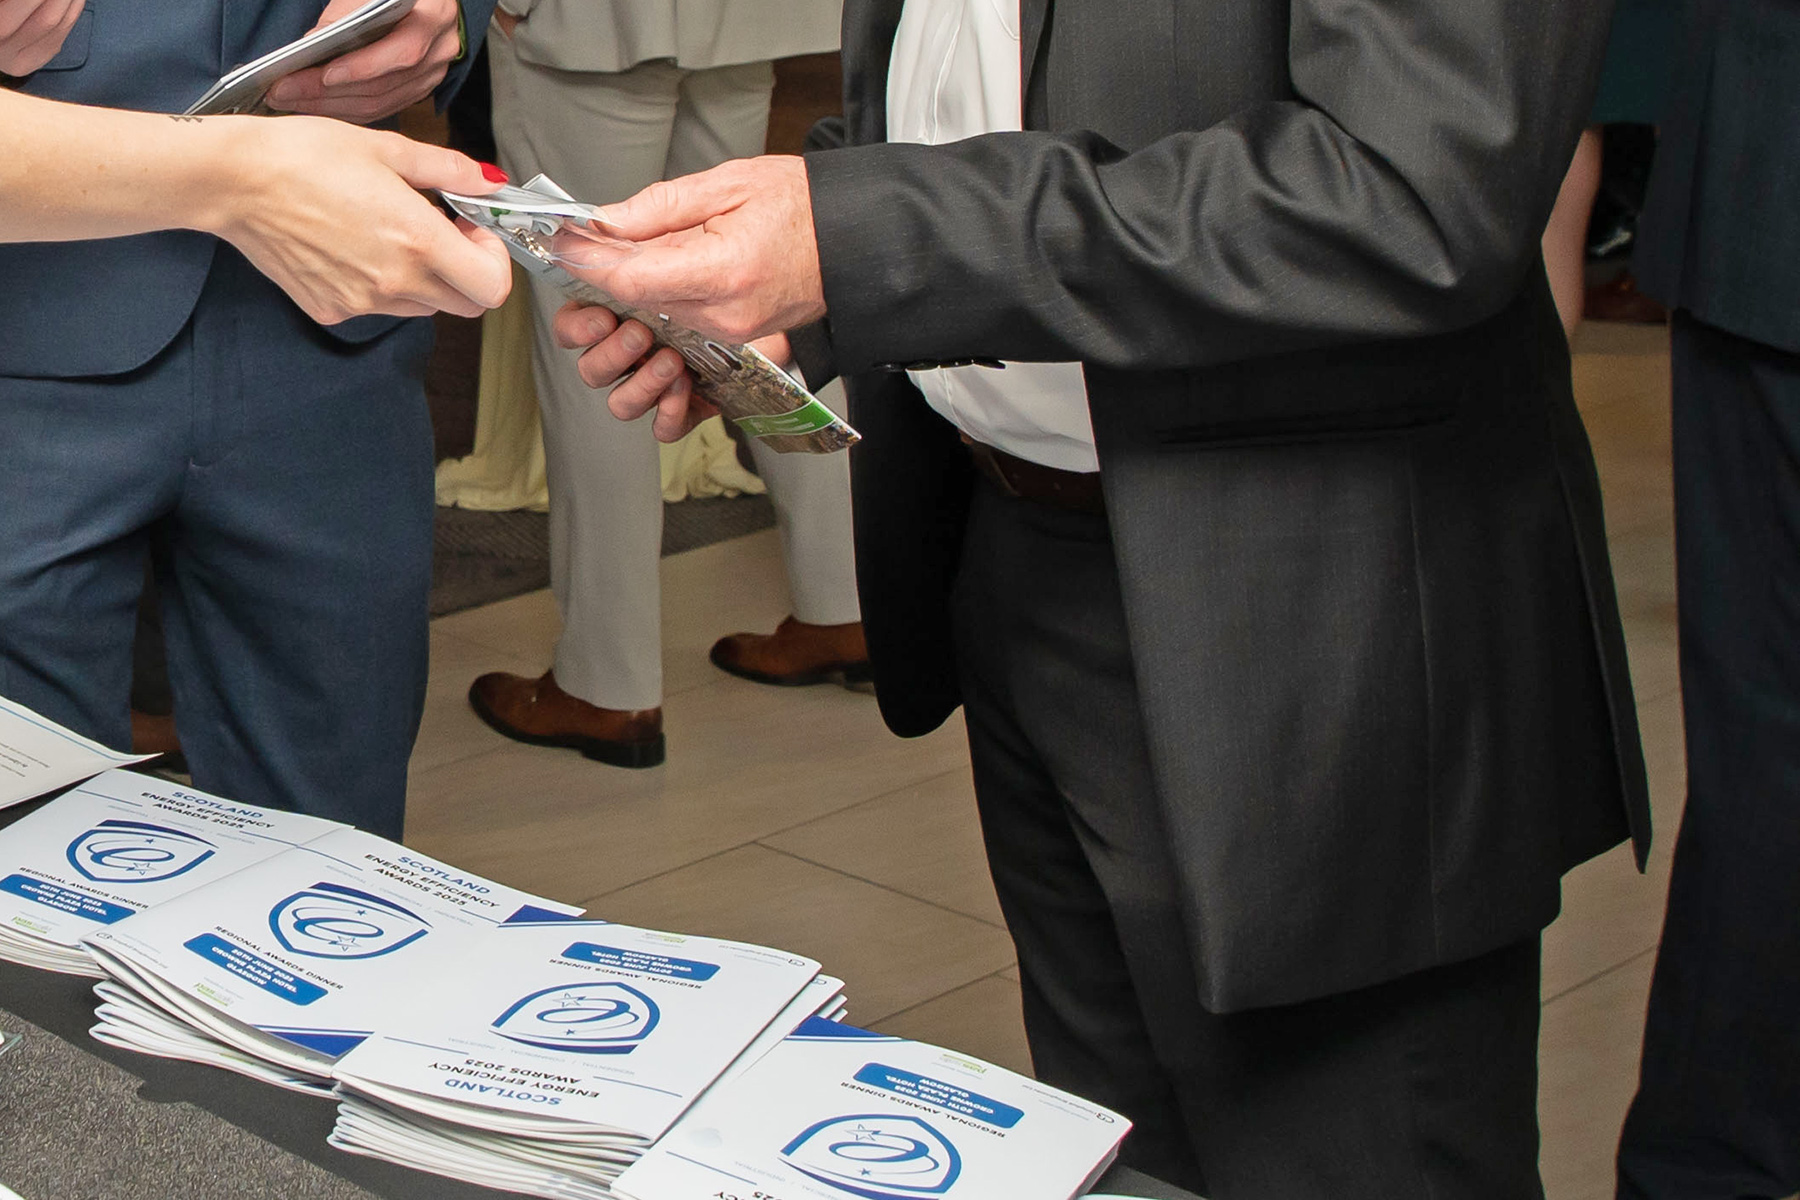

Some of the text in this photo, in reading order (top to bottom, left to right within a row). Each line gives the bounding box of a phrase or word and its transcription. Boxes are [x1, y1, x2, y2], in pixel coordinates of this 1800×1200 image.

[141, 792, 275, 828] ENERGY EFFICIENCY
[152, 803, 244, 829] AWARDS 2025
[172, 791, 263, 818] SCOTLAND
[19, 866, 149, 909] REGIONAL AWARDS DINNER
[364, 854, 500, 908] ENERGY EFFICIENCY
[374, 867, 467, 906] AWARDS 2025
[398, 856, 490, 894] SCOTLAND
[20, 883, 107, 916] CROWNE PLAZA HOTEL
[37, 896, 78, 913] GLASGOW
[211, 946, 298, 993] CROWNE PLAZA HOTEL
[214, 925, 344, 990] REGIONAL AWARDS DINNER
[549, 958, 702, 989] REGIONAL AWARDS DINNER
[590, 950, 692, 973] CROWNE PLAZA HOTEL
[623, 951, 669, 963] GLASGOW
[226, 962, 268, 986] GLASGOW
[428, 1062, 600, 1098] ENERGY EFFICIENCY
[464, 1058, 583, 1085] AWARDS 2025
[919, 1077, 969, 1099] GLASGOW
[444, 1078, 562, 1106] SCOTLAND
[885, 1074, 994, 1115] CROWNE PLAZA HOTEL
[840, 1081, 1006, 1138] REGIONAL AWARDS DINNER
